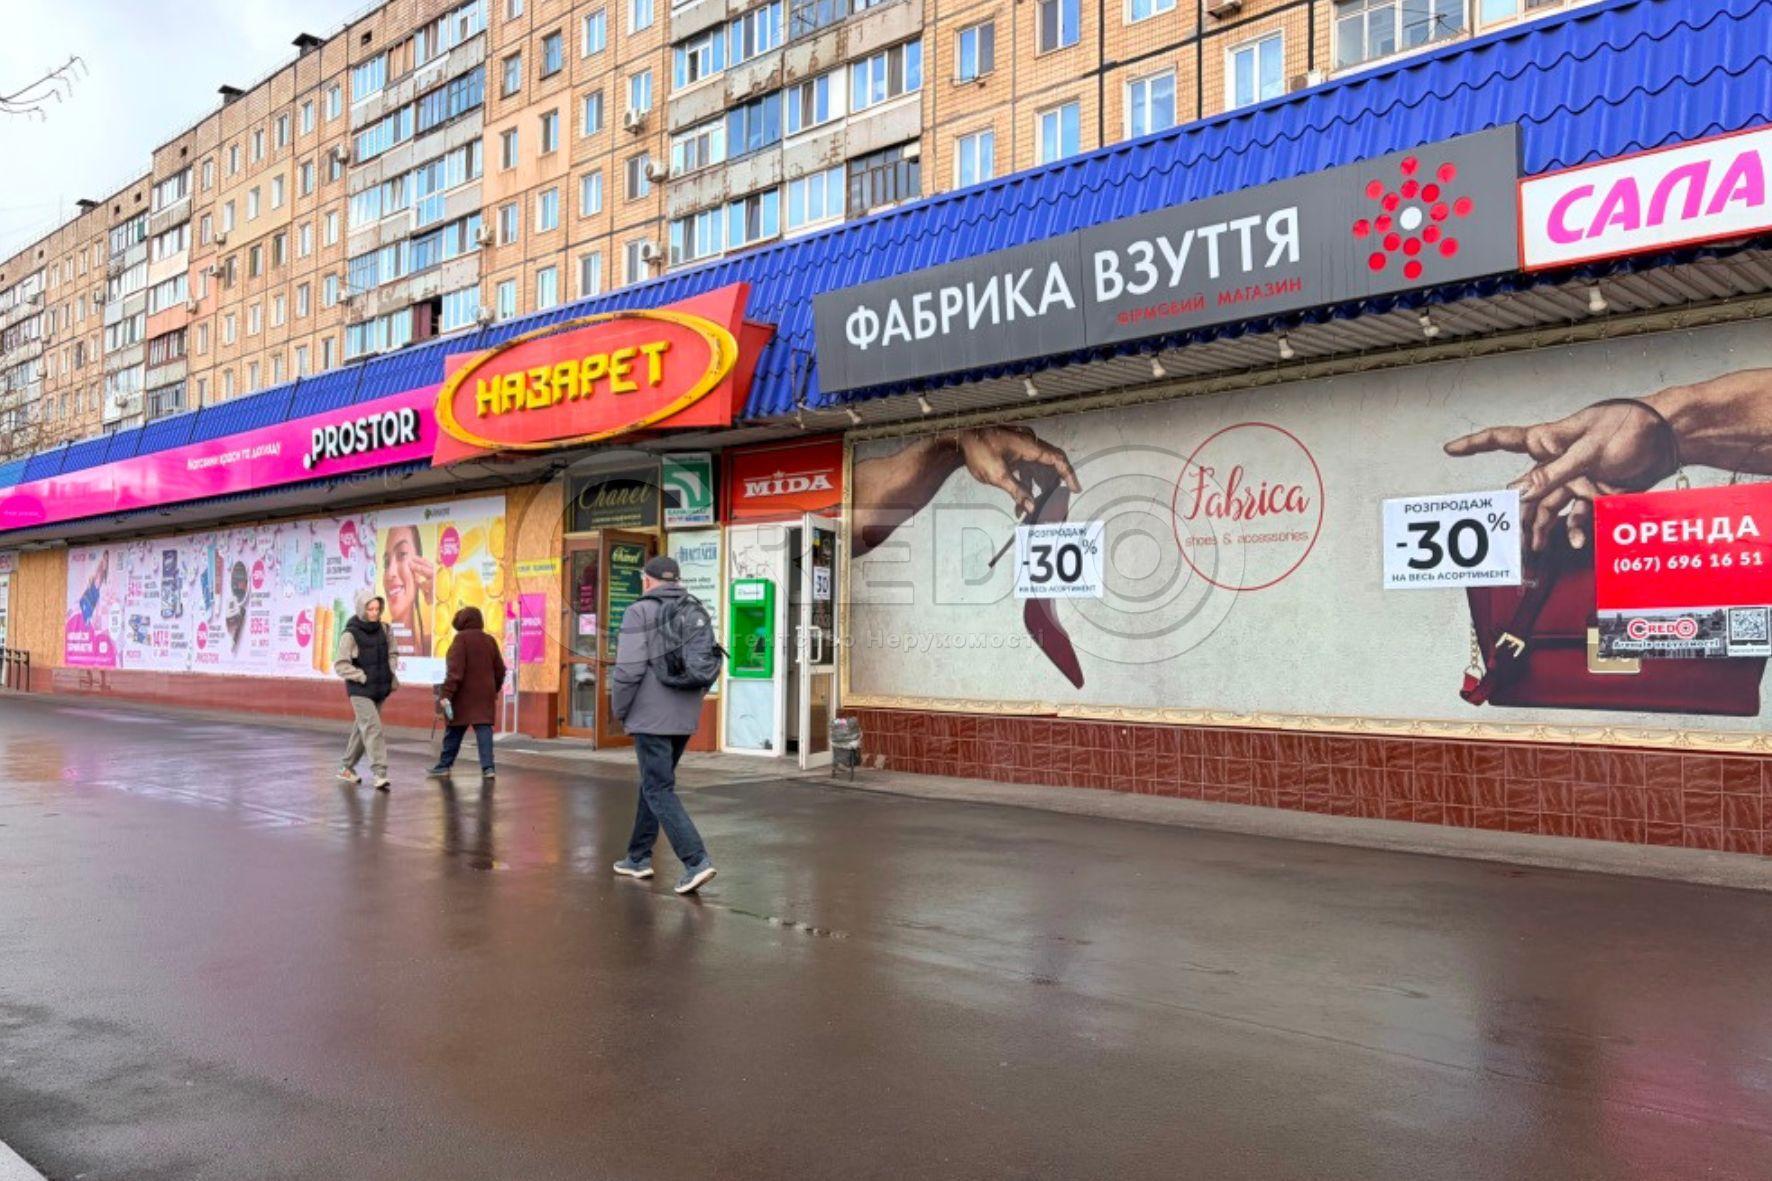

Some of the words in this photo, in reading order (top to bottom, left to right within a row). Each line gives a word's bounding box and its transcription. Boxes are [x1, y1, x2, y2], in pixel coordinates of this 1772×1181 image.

[845, 262, 1075, 351] ФАБРИКА
[1094, 206, 1299, 303] ВЗУТТЯ
[1218, 277, 1302, 306] МАГАЗИН
[475, 340, 672, 418] НАЗАРЕТ
[579, 475, 651, 510] Chanel
[744, 474, 835, 498] MIDA
[1183, 464, 1311, 522] Fabrica
[1404, 498, 1493, 514] РОЗПРОДАЖ
[1028, 528, 1087, 538] РОЗПРОДАЖ
[1185, 534, 1218, 547] shoes
[1223, 533, 1233, 545] &
[1613, 515, 1760, 545] ОРЕНДА
[1613, 555, 1660, 574] (067)
[1667, 554, 1702, 569] 696
[1710, 553, 1732, 567] 16
[1740, 551, 1764, 566] 51
[1392, 574, 1406, 582] НА
[1409, 572, 1435, 581] ВЕСЬ
[1437, 569, 1511, 580] АСОРТИМЕНТ
[1628, 618, 1697, 639] CREDO
